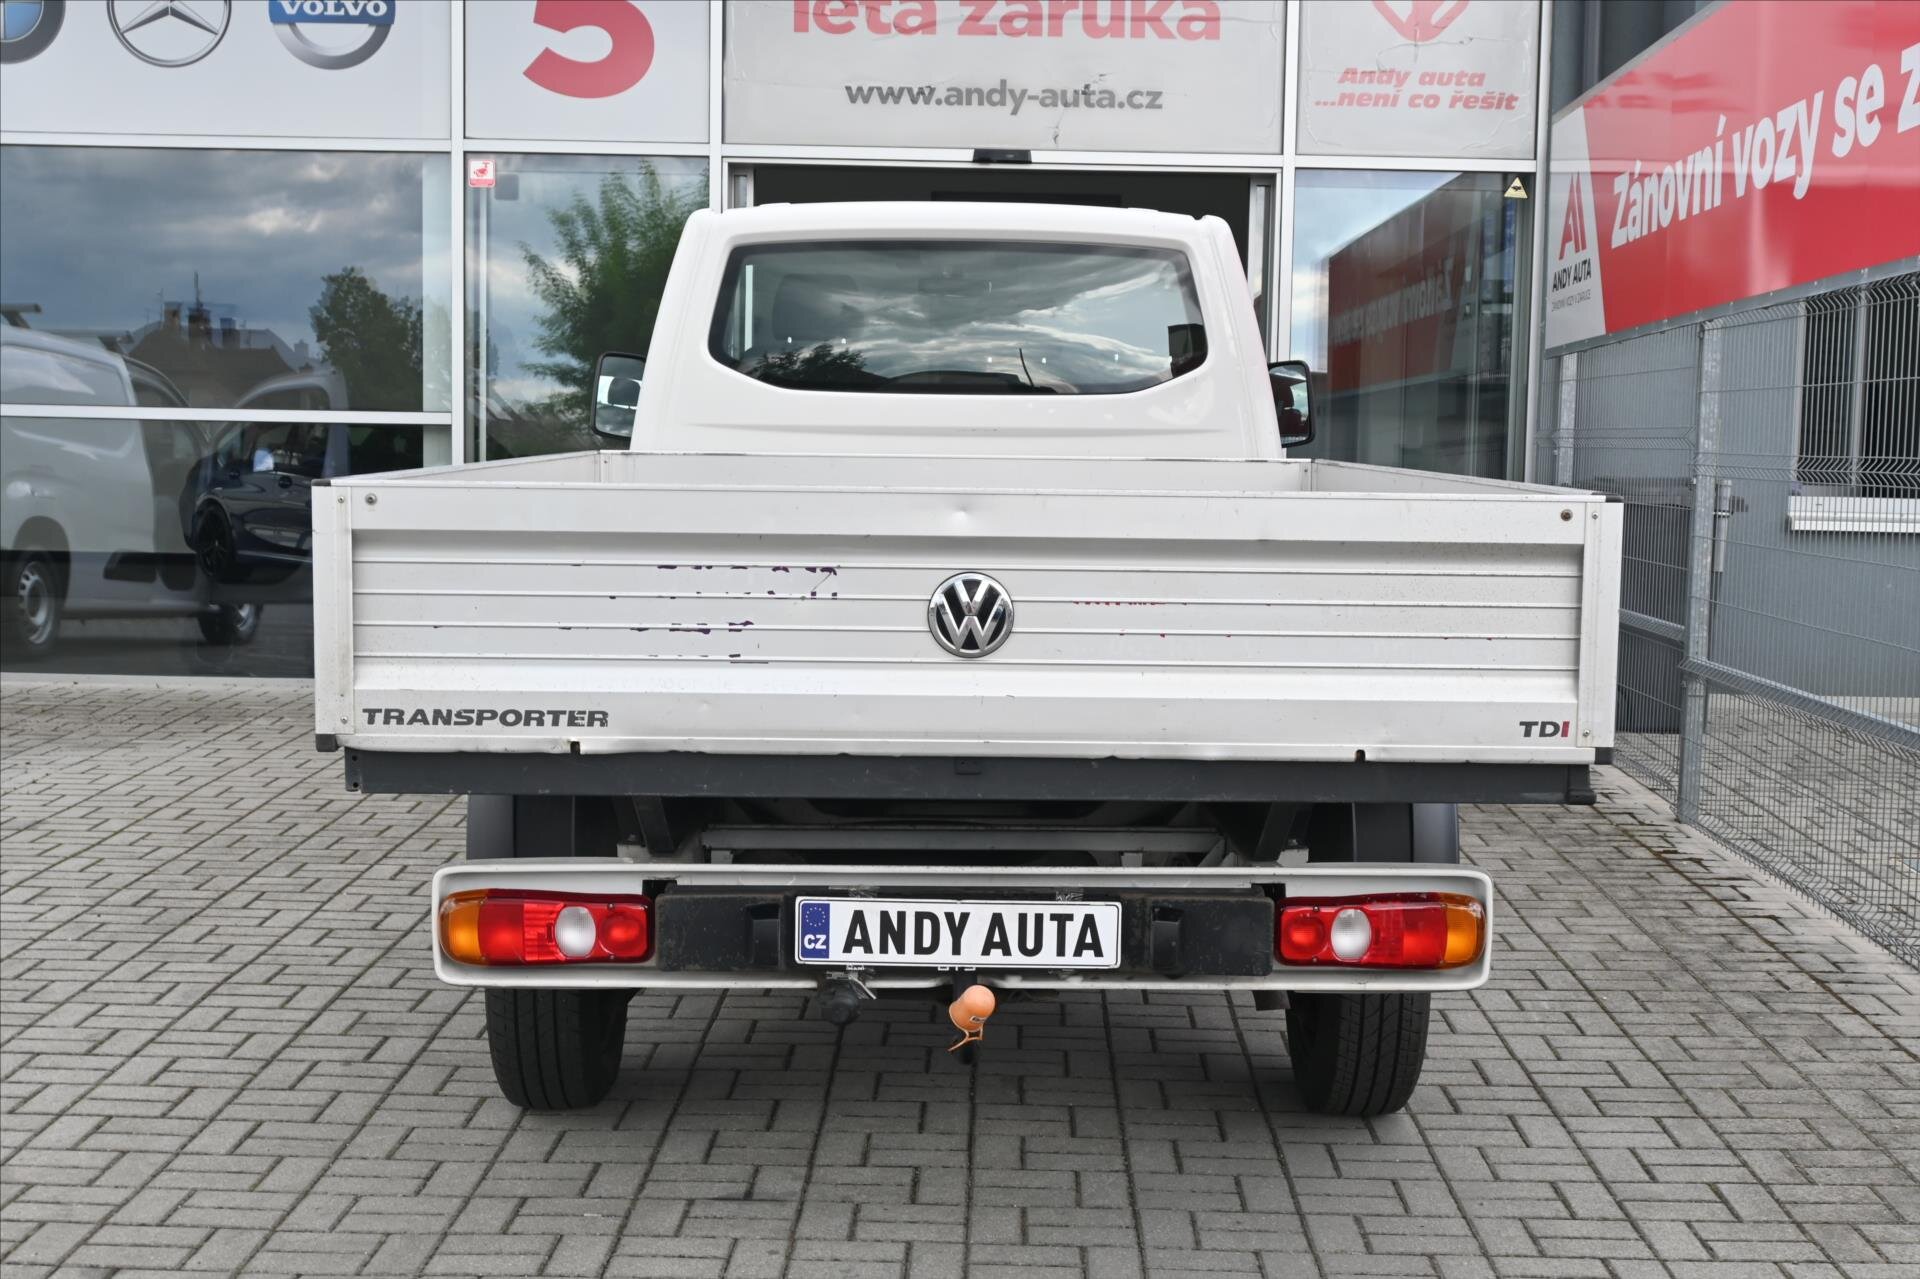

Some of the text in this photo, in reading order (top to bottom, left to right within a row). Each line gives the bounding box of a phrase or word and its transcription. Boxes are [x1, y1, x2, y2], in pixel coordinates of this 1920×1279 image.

[280, 0, 388, 16] VOLVO
[1337, 67, 1486, 88] Andy auta
[845, 79, 1163, 116] www.andy-auta.cz
[1408, 92, 1441, 109] co
[1448, 90, 1519, 111] řešit
[1611, 114, 1727, 249] Zánovní
[1732, 89, 1824, 200] vozy
[1831, 63, 1885, 158] se
[1552, 258, 1592, 292] ANDY AUTA
[362, 708, 609, 727] TRANSPORTER
[1519, 721, 1570, 738] TDI
[803, 934, 827, 949] CZ
[842, 909, 1104, 958] ANDY AUTA
